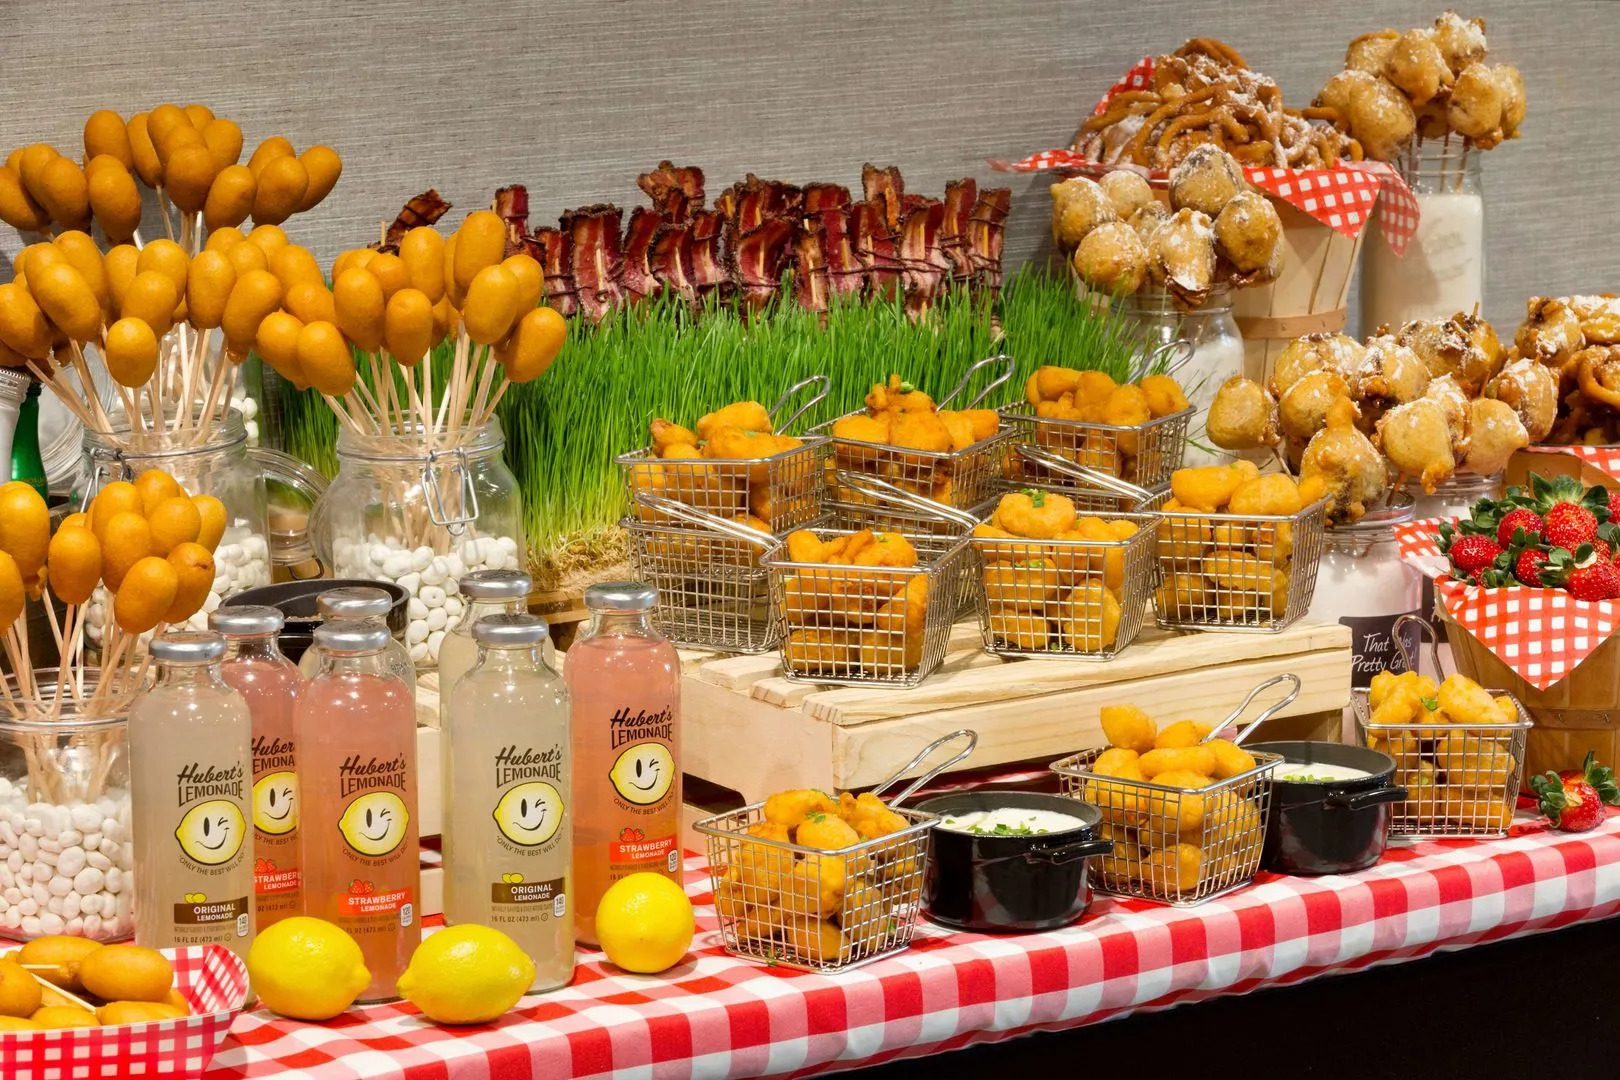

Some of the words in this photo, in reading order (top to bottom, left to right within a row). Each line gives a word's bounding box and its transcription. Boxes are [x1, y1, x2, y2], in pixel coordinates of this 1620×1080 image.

[1363, 632, 1389, 653] That
[1352, 654, 1387, 673] Pretty
[610, 705, 672, 729] Hubert's
[612, 723, 672, 750] LEMONADE
[495, 744, 562, 767] Hubert's
[340, 752, 407, 777] Hubert's
[177, 760, 243, 785] Hubert's
[496, 762, 562, 788] LEMONADE
[341, 772, 406, 798] LEMONADE
[178, 780, 243, 808] LEMONADE
[630, 806, 642, 815] THE
[514, 848, 526, 856] THE
[528, 848, 542, 856] BEST
[620, 840, 672, 852] STRAWBERRY
[632, 848, 664, 859] LEMONADE
[360, 857, 370, 866] THE
[372, 858, 388, 866] BEST
[196, 867, 208, 876] THE
[264, 880, 296, 890] LEMONADE
[511, 884, 552, 894] ORIGINAL
[348, 892, 406, 904] STRAWBERRY
[514, 892, 550, 902] LEMONADE
[194, 904, 236, 914] ORIGINAL
[360, 903, 396, 912] LEMONADE
[196, 912, 233, 922] LEMONADE
